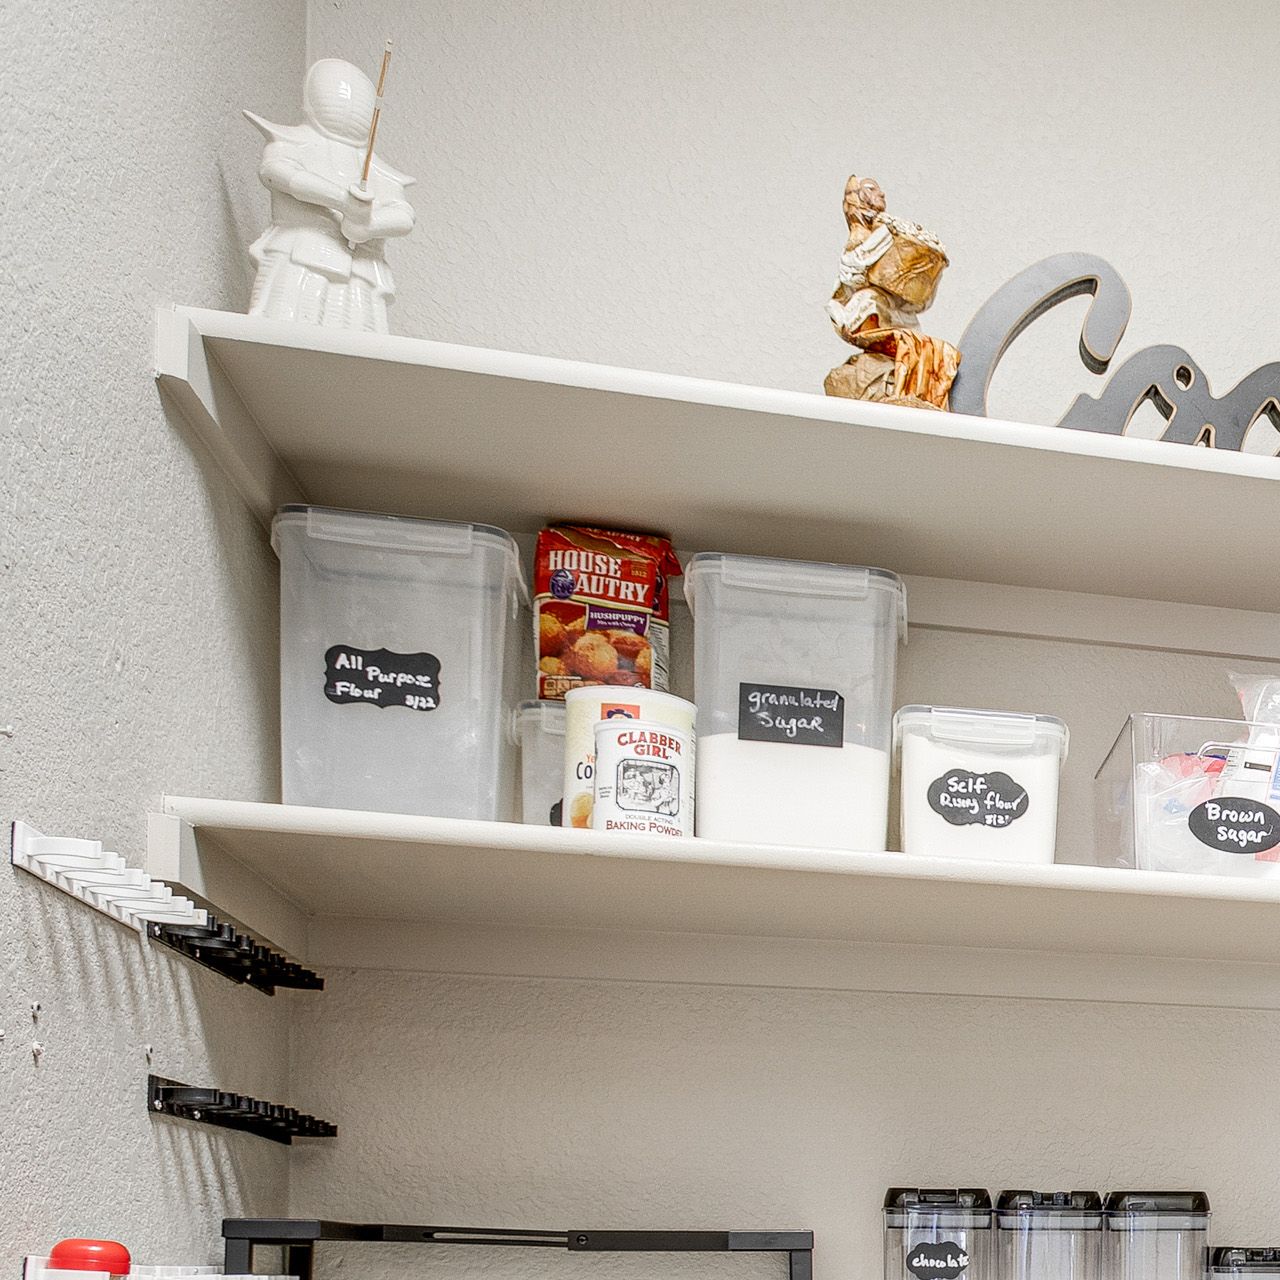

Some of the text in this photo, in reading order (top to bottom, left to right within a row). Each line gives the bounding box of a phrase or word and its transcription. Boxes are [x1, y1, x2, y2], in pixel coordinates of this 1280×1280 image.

[549, 551, 621, 578] HOUSE
[574, 573, 649, 603] AUTRY
[590, 611, 645, 625] HUSHPUPPY
[335, 653, 363, 670] All
[335, 681, 382, 699] Flour
[748, 691, 839, 712] granulated
[617, 731, 681, 756] CLABBER
[633, 744, 670, 760] GIRL
[948, 776, 988, 793] Self
[1205, 800, 1265, 824] Brown
[606, 820, 647, 832] BAKING
[911, 1253, 970, 1269] chocolate
